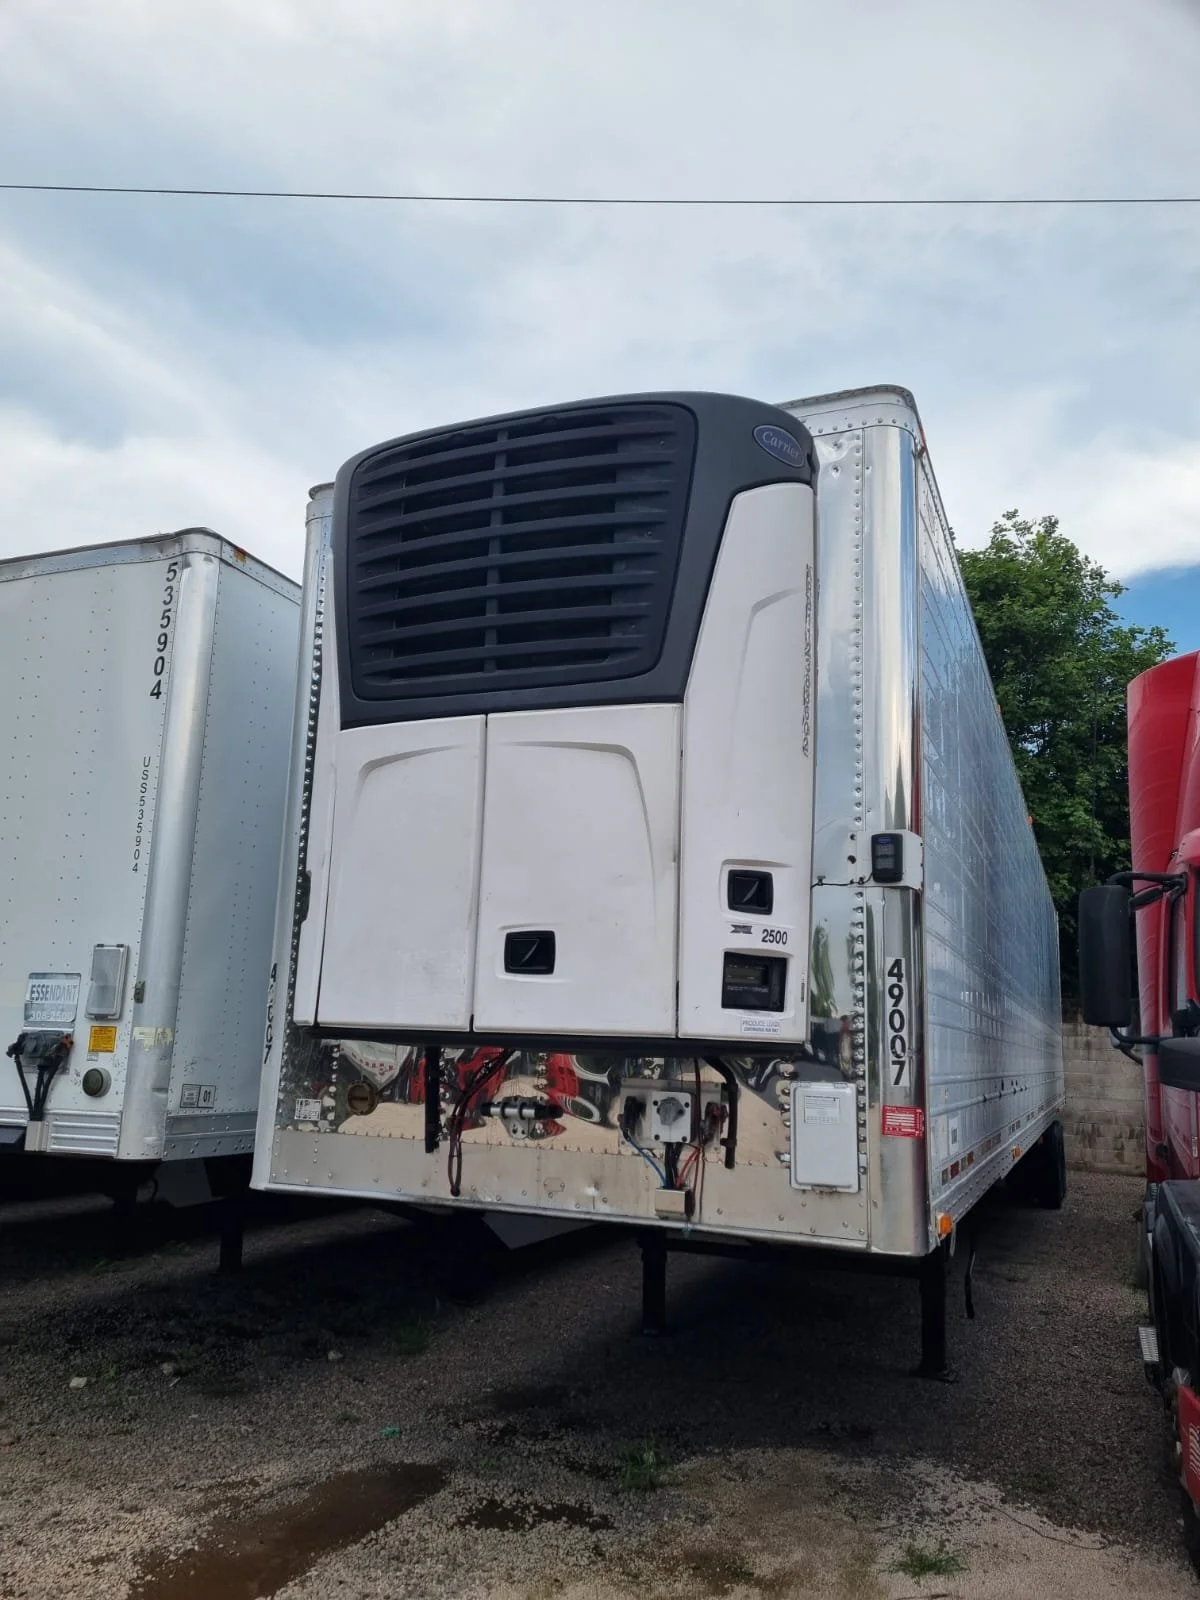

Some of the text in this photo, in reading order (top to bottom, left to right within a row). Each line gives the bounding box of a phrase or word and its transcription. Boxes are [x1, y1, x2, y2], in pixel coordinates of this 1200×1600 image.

[762, 431, 799, 459] Carrier
[149, 561, 179, 700] 535904
[761, 928, 788, 945] 2500
[30, 983, 79, 1002] ESSENDANT
[887, 958, 908, 1086] 49007
